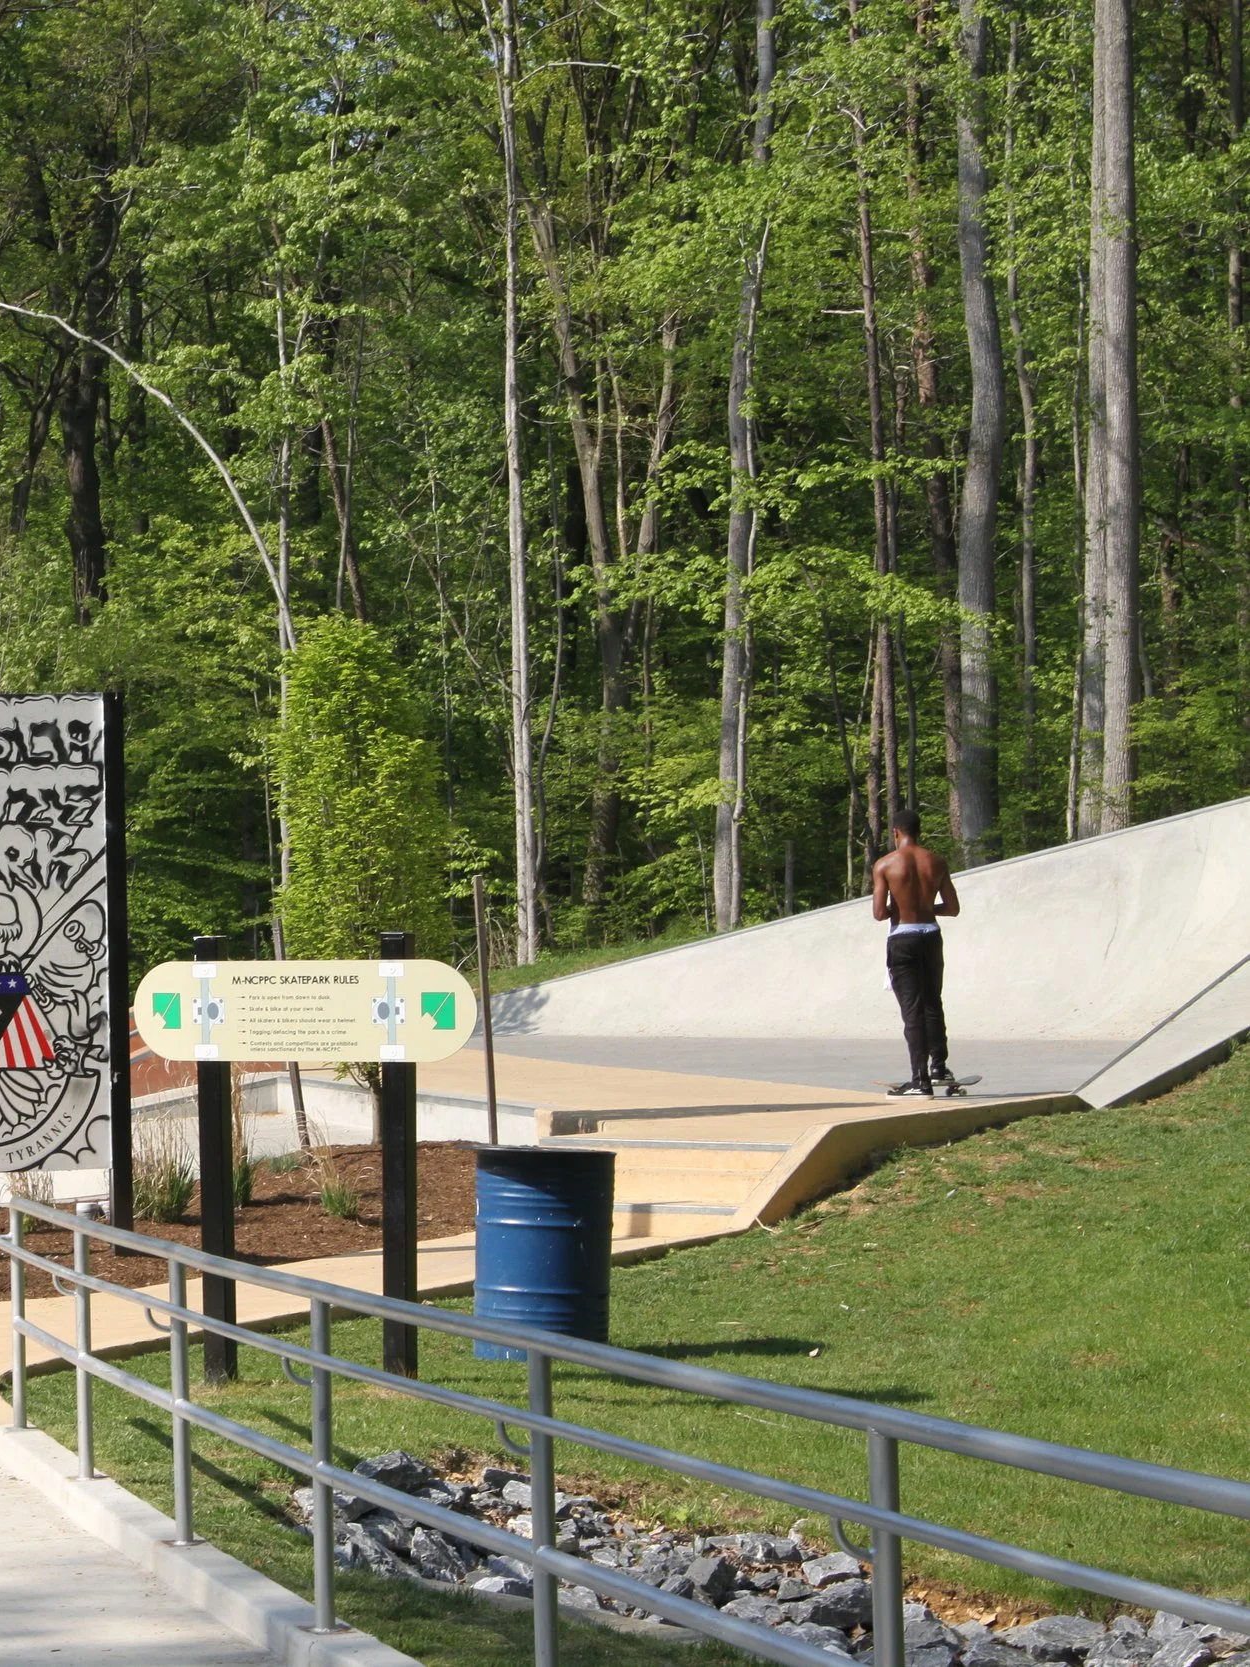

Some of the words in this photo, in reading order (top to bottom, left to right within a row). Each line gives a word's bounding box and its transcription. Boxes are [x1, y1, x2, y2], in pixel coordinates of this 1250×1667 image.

[231, 975, 277, 985] M-NCPPC
[279, 975, 331, 985] SKATEPARK
[333, 975, 360, 985] RULES
[5, 1112, 73, 1165] TYRANNIS
